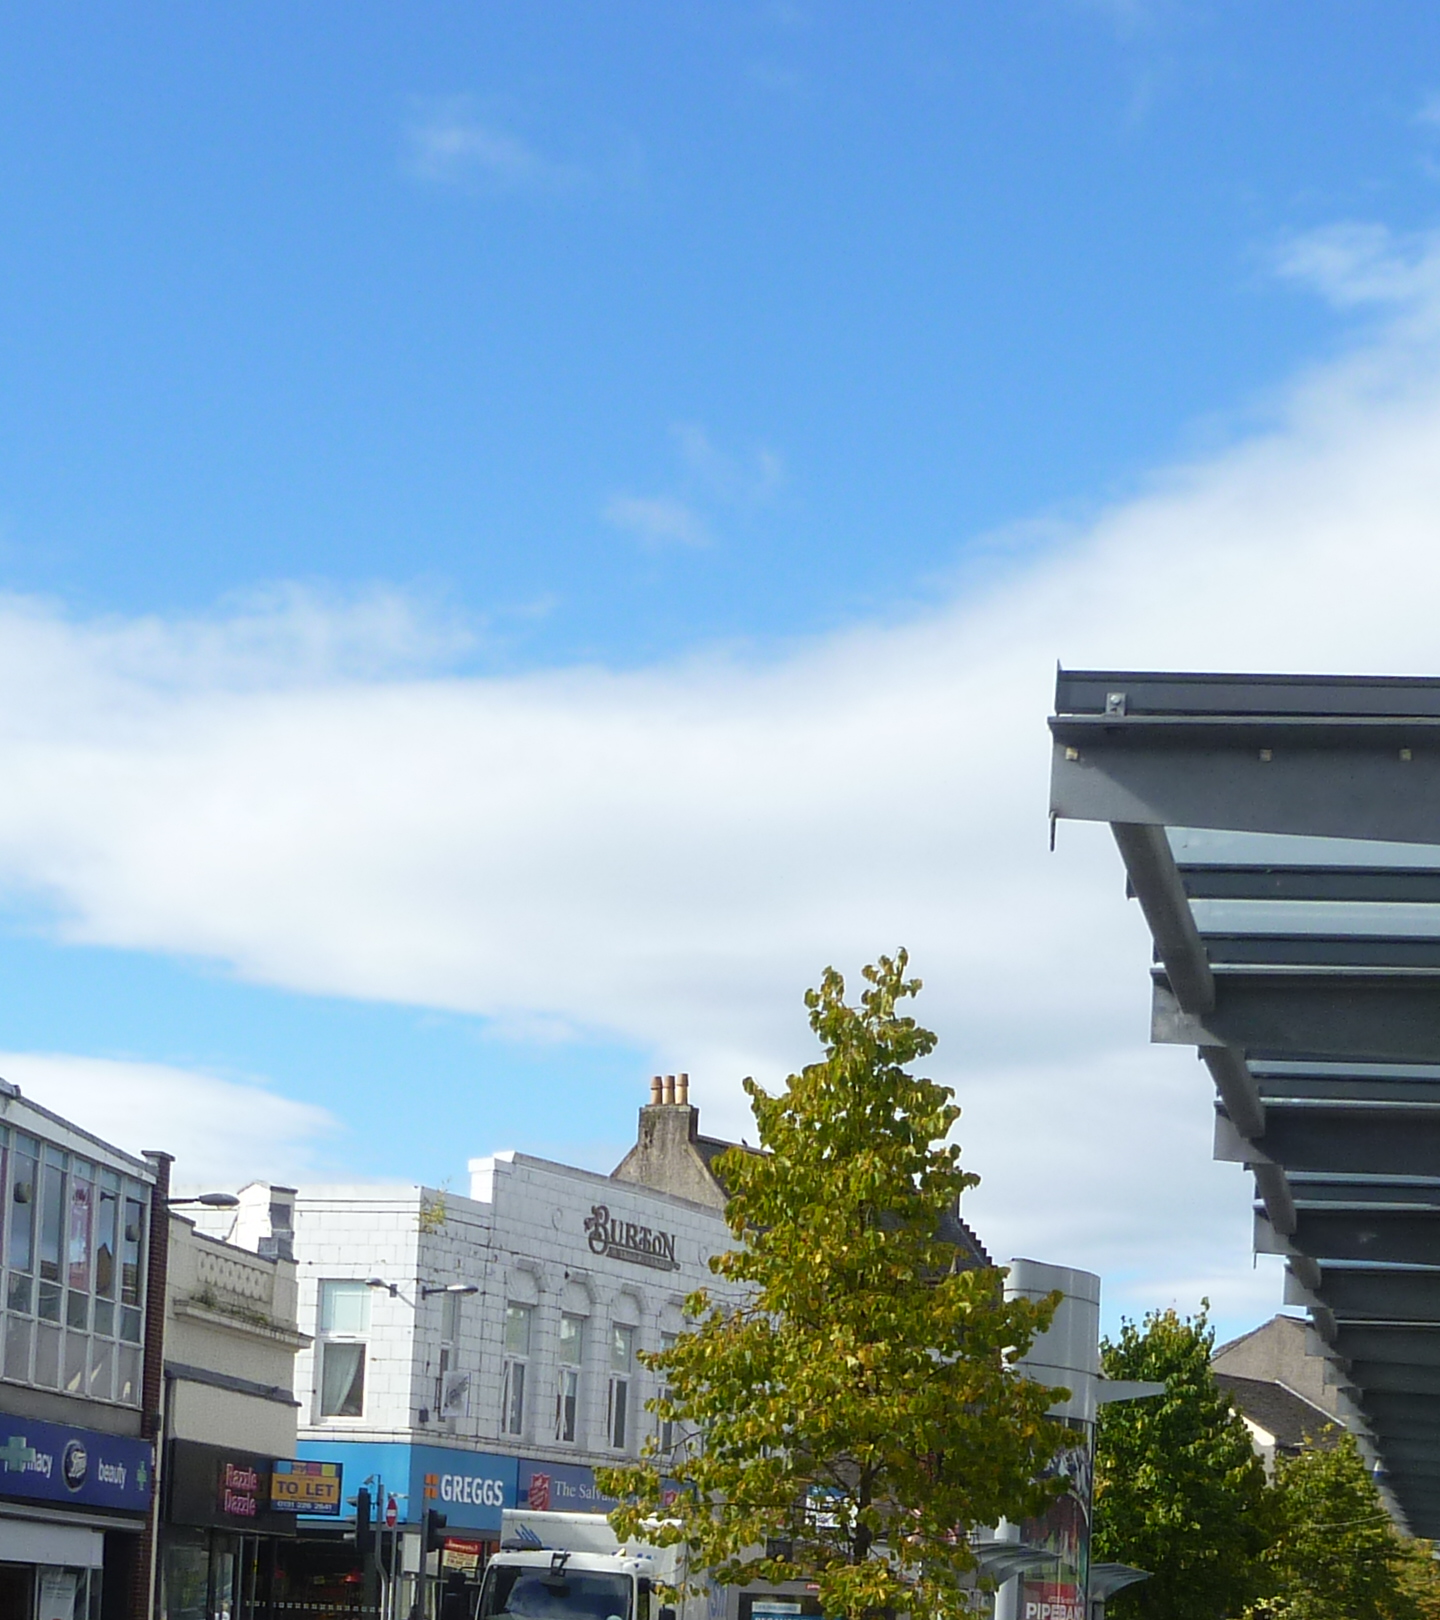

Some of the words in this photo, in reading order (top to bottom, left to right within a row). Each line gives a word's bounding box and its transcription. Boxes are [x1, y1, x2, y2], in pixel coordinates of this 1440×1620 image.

[98, 1457, 128, 1490] beauty
[225, 1462, 258, 1491] Razzle
[277, 1481, 299, 1494] TO
[306, 1483, 335, 1497] LET
[441, 1473, 503, 1506] GREGGS
[554, 1480, 577, 1497] The
